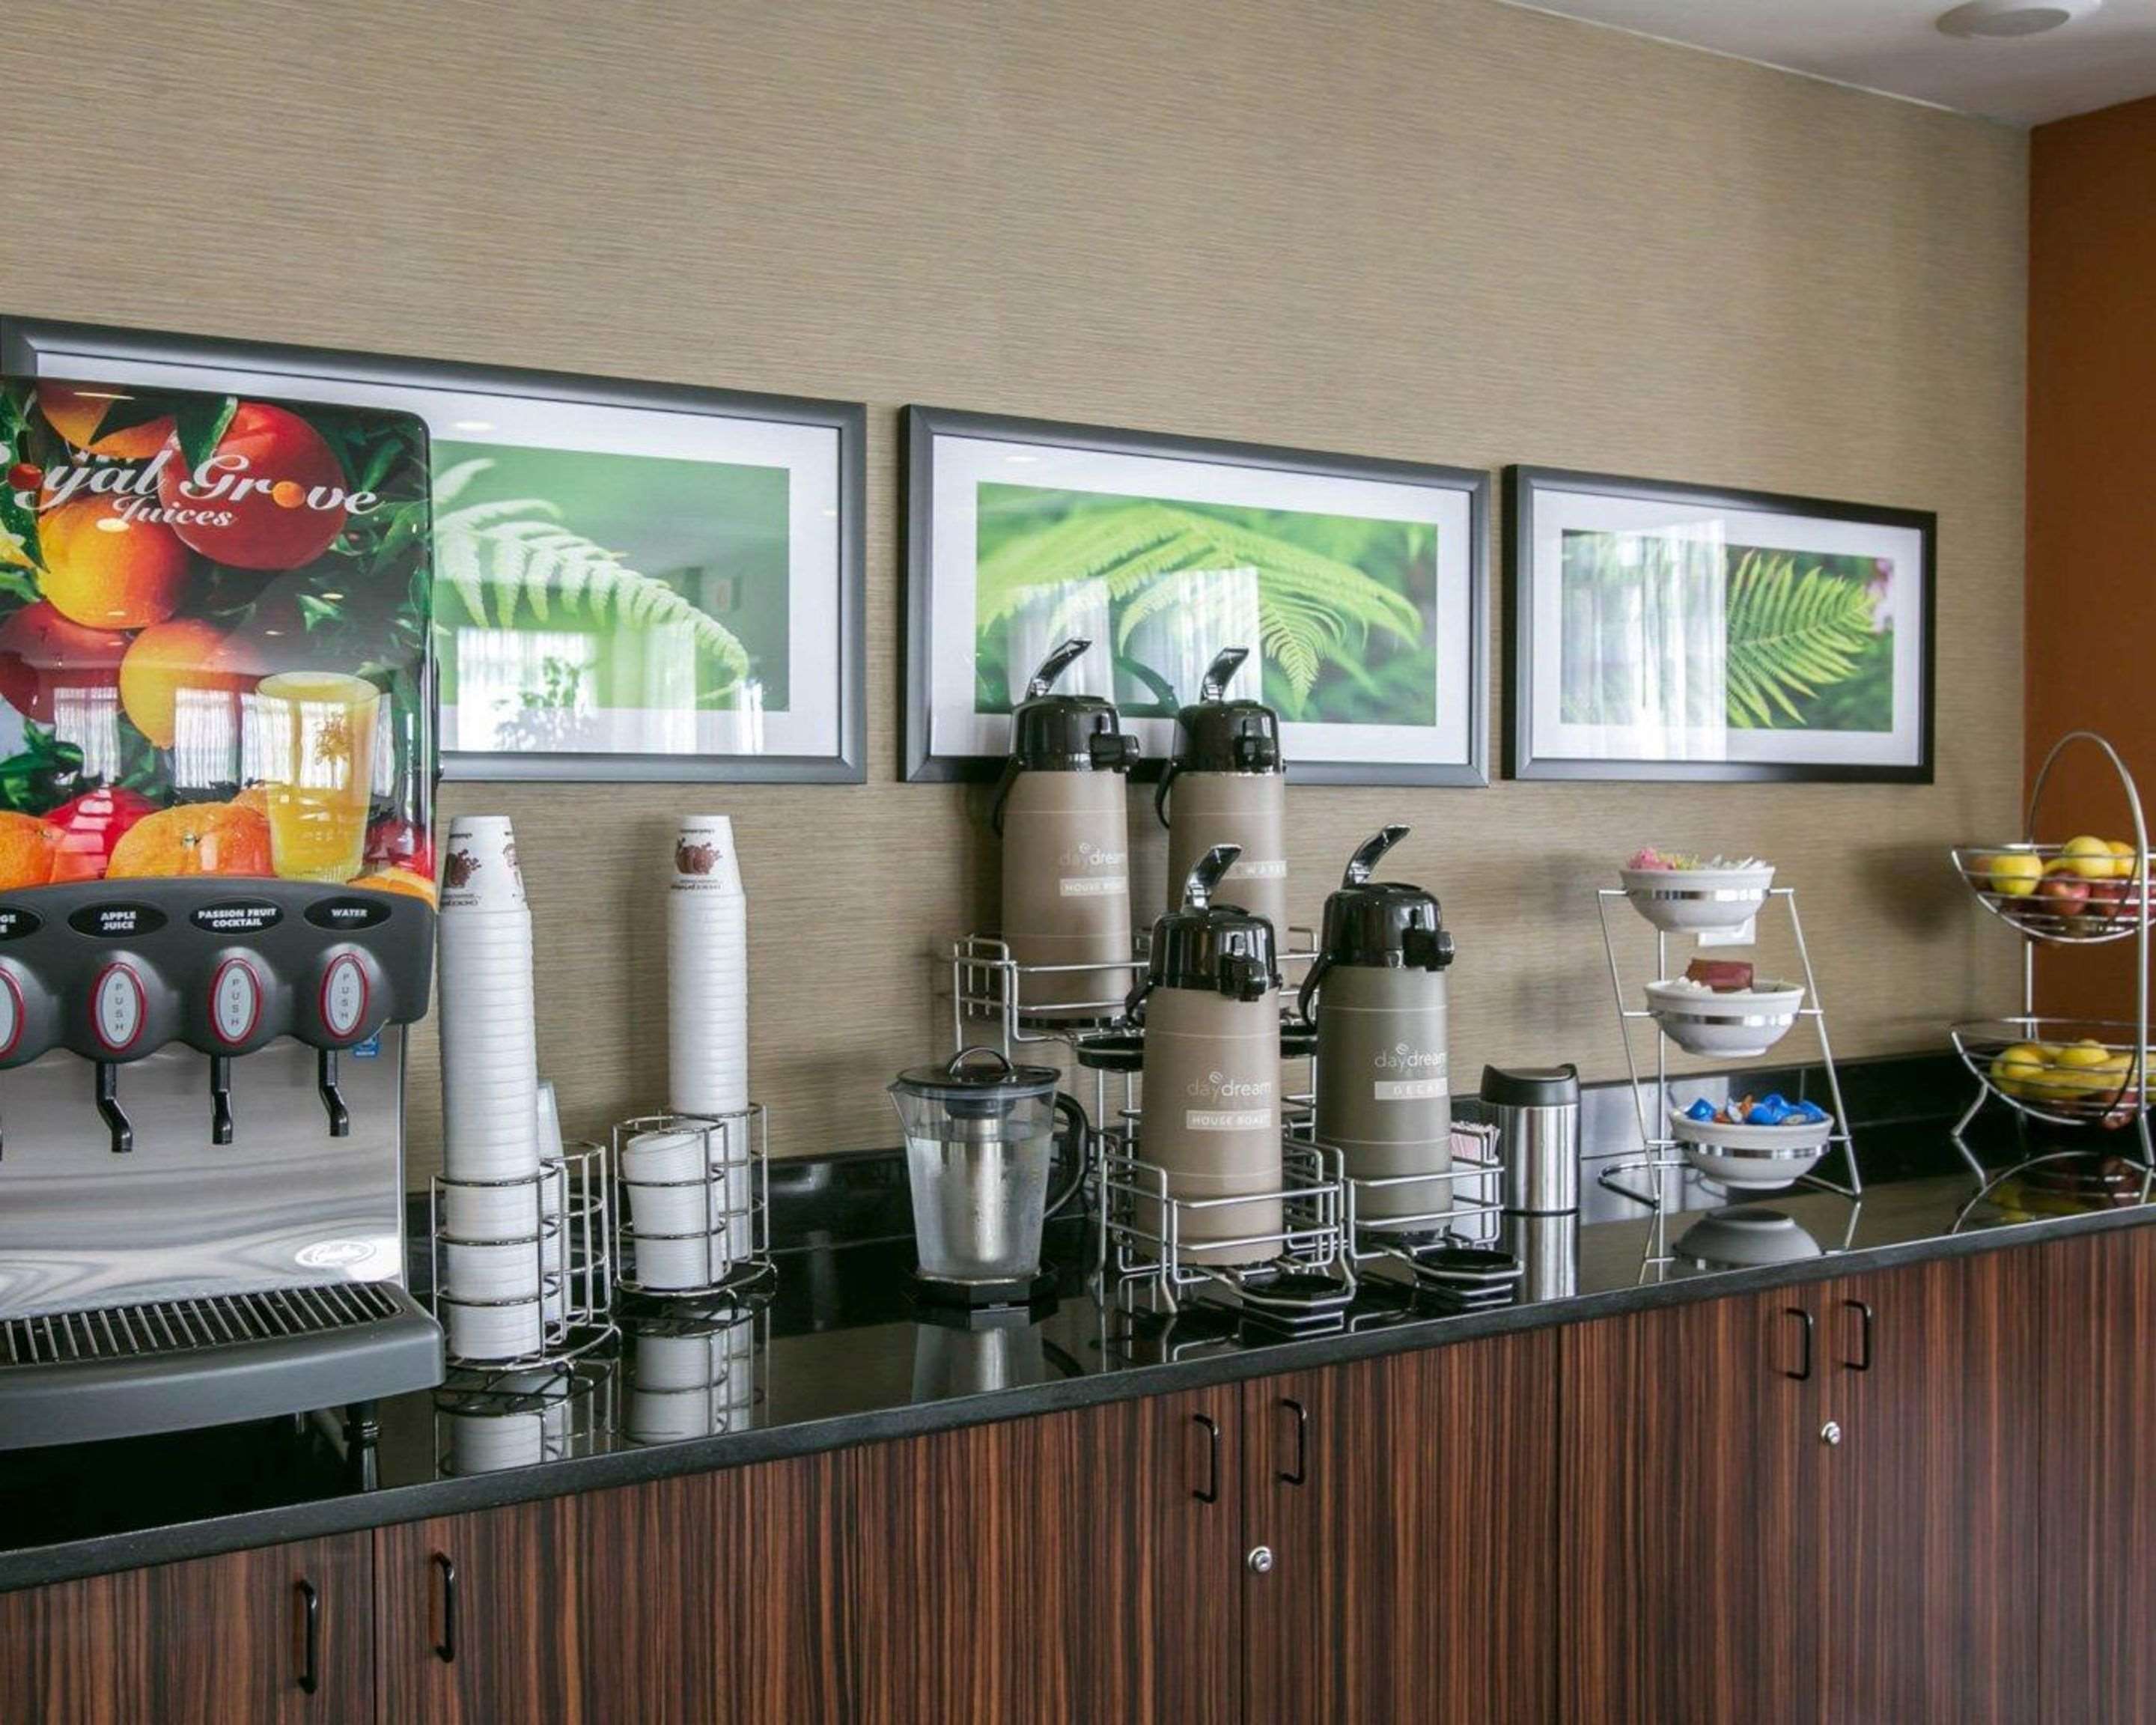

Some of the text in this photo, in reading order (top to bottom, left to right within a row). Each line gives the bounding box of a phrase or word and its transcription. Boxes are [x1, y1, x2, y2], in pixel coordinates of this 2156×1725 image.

[0, 449, 384, 515] oyal Grove
[113, 495, 238, 526] Juices
[100, 910, 137, 921] APPLE
[198, 907, 277, 919] PASSION FRUIT
[331, 908, 368, 918] WATER
[103, 921, 135, 931] JUICE
[212, 917, 263, 928] COCKTAIL
[115, 983, 124, 1031] PUSH
[231, 979, 240, 1026] PUSH
